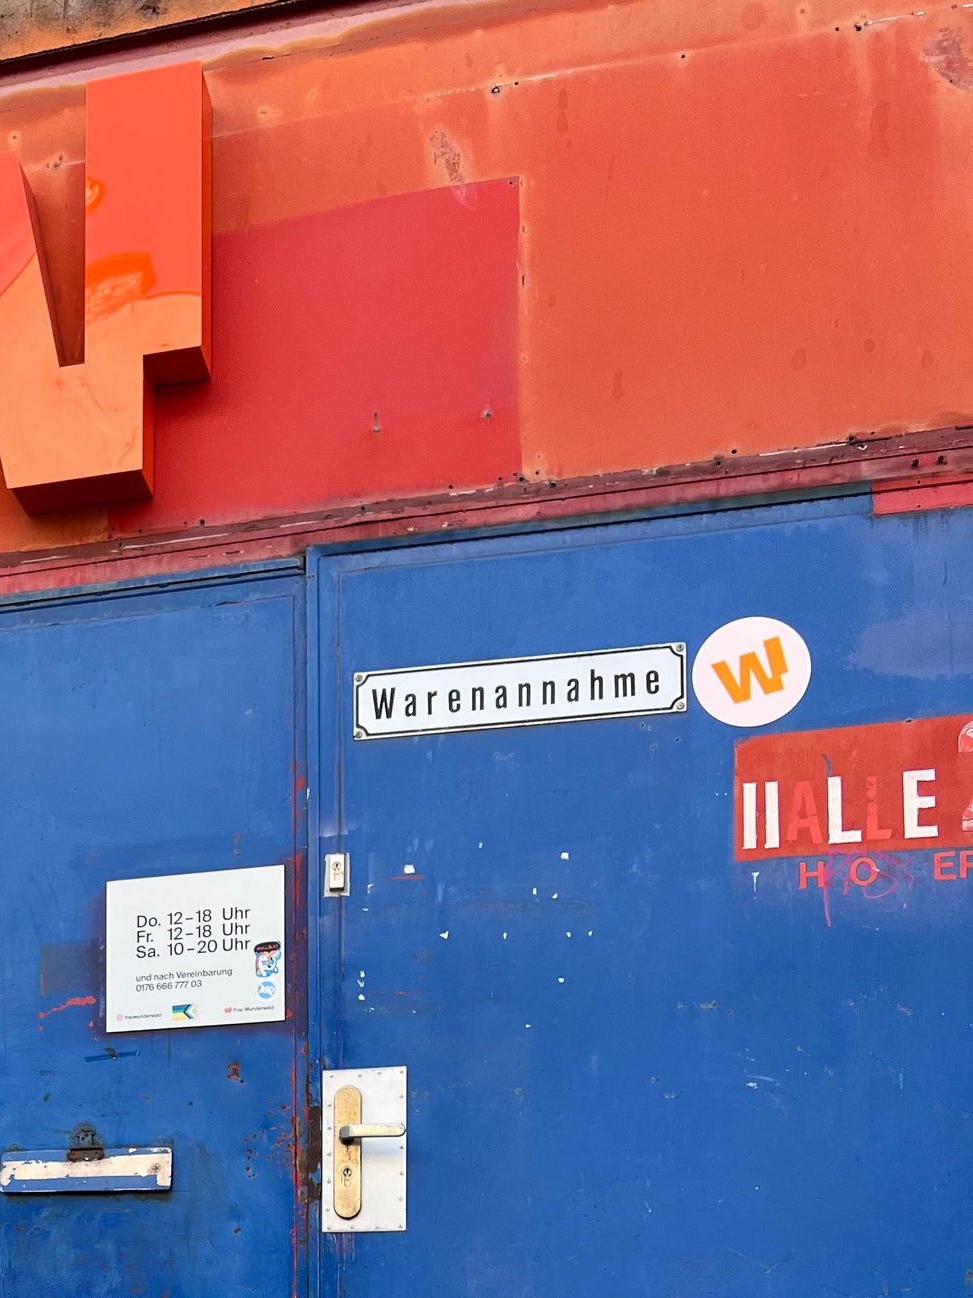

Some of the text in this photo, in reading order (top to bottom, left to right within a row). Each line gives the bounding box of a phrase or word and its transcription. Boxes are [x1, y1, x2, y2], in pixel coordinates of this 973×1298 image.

[711, 636, 788, 704] W
[372, 669, 660, 720] Warenannahme
[136, 915, 161, 928] Do.
[222, 907, 251, 921] Uhr
[136, 930, 154, 943] Fr.
[222, 922, 251, 936] Uhr
[136, 945, 160, 959] Sa.
[222, 938, 251, 952] Uhr
[135, 969, 233, 982] und nach Vereinbarung
[135, 980, 203, 992] 0176 666 777 03
